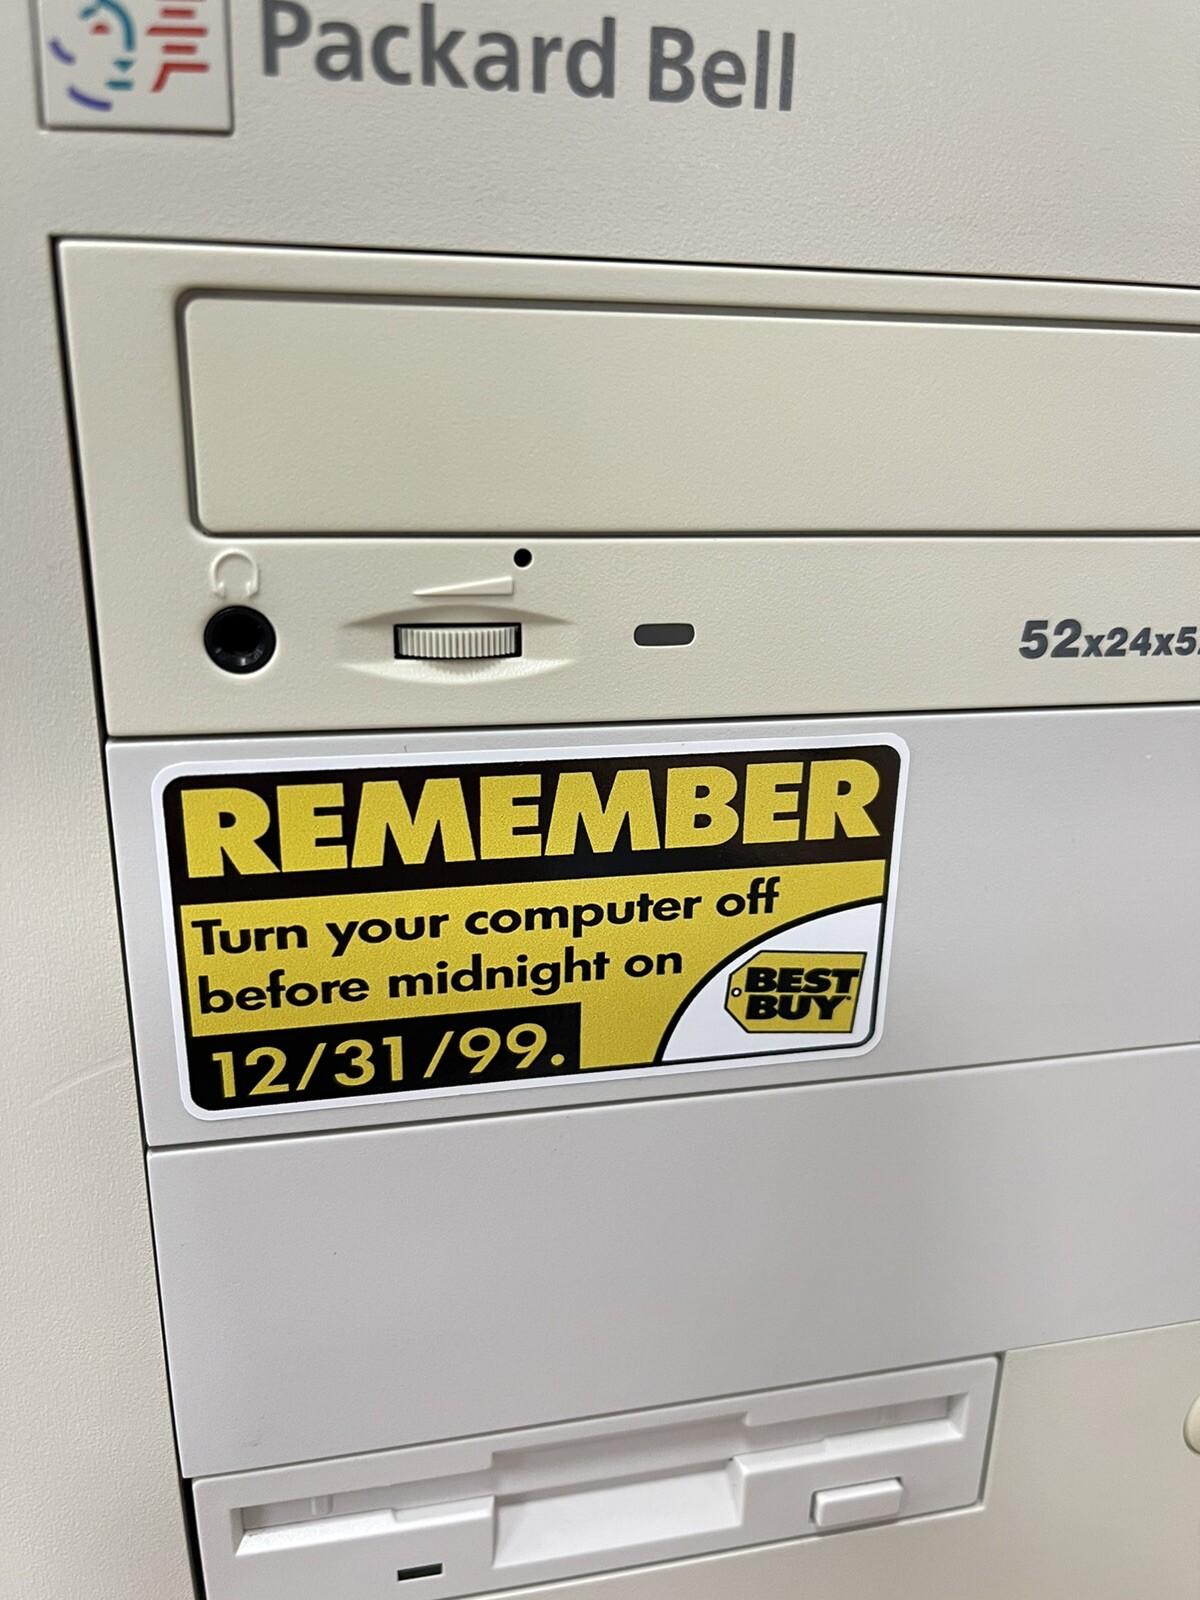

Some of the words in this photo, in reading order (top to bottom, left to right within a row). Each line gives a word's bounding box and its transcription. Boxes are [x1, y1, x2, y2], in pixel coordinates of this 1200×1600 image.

[260, 0, 616, 99] Packard
[648, 25, 796, 111] Bell
[1018, 618, 1200, 659] 52x24x5
[181, 759, 880, 878] REMEMBER
[191, 918, 308, 955] Turn
[326, 913, 450, 957] your
[464, 893, 702, 938] computer
[715, 876, 781, 916] off
[198, 968, 370, 1014] before
[388, 946, 610, 998] midnight
[623, 951, 683, 976] on
[745, 966, 861, 994] BEST
[745, 994, 848, 1020] BUY
